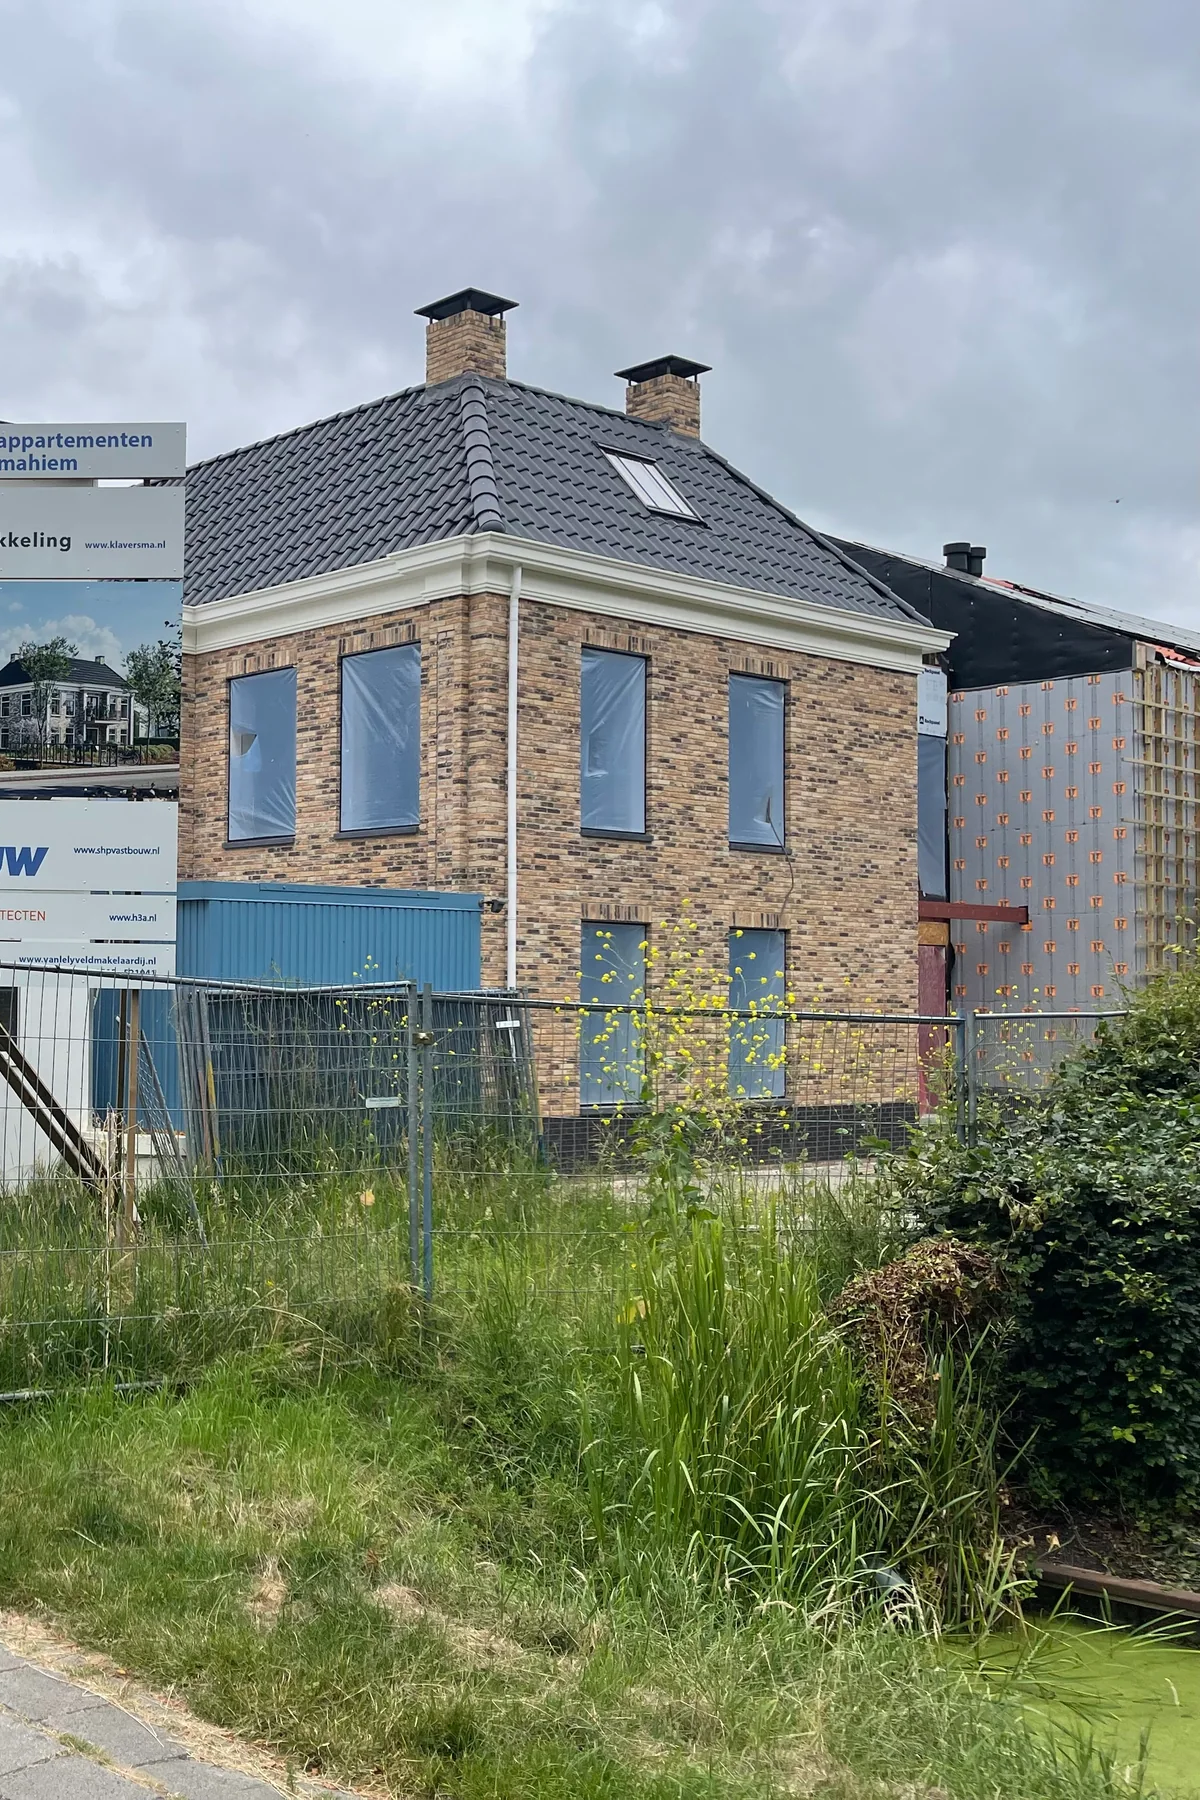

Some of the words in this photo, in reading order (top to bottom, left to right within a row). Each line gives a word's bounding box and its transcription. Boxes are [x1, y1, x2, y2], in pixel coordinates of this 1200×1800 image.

[85, 540, 166, 549] www.klaversma.nl
[74, 846, 160, 855] www.shpvastbouw.nl
[109, 913, 157, 922] www.h3a.nl
[19, 954, 156, 966] www.vanlelyveldmakelaardij.nl
